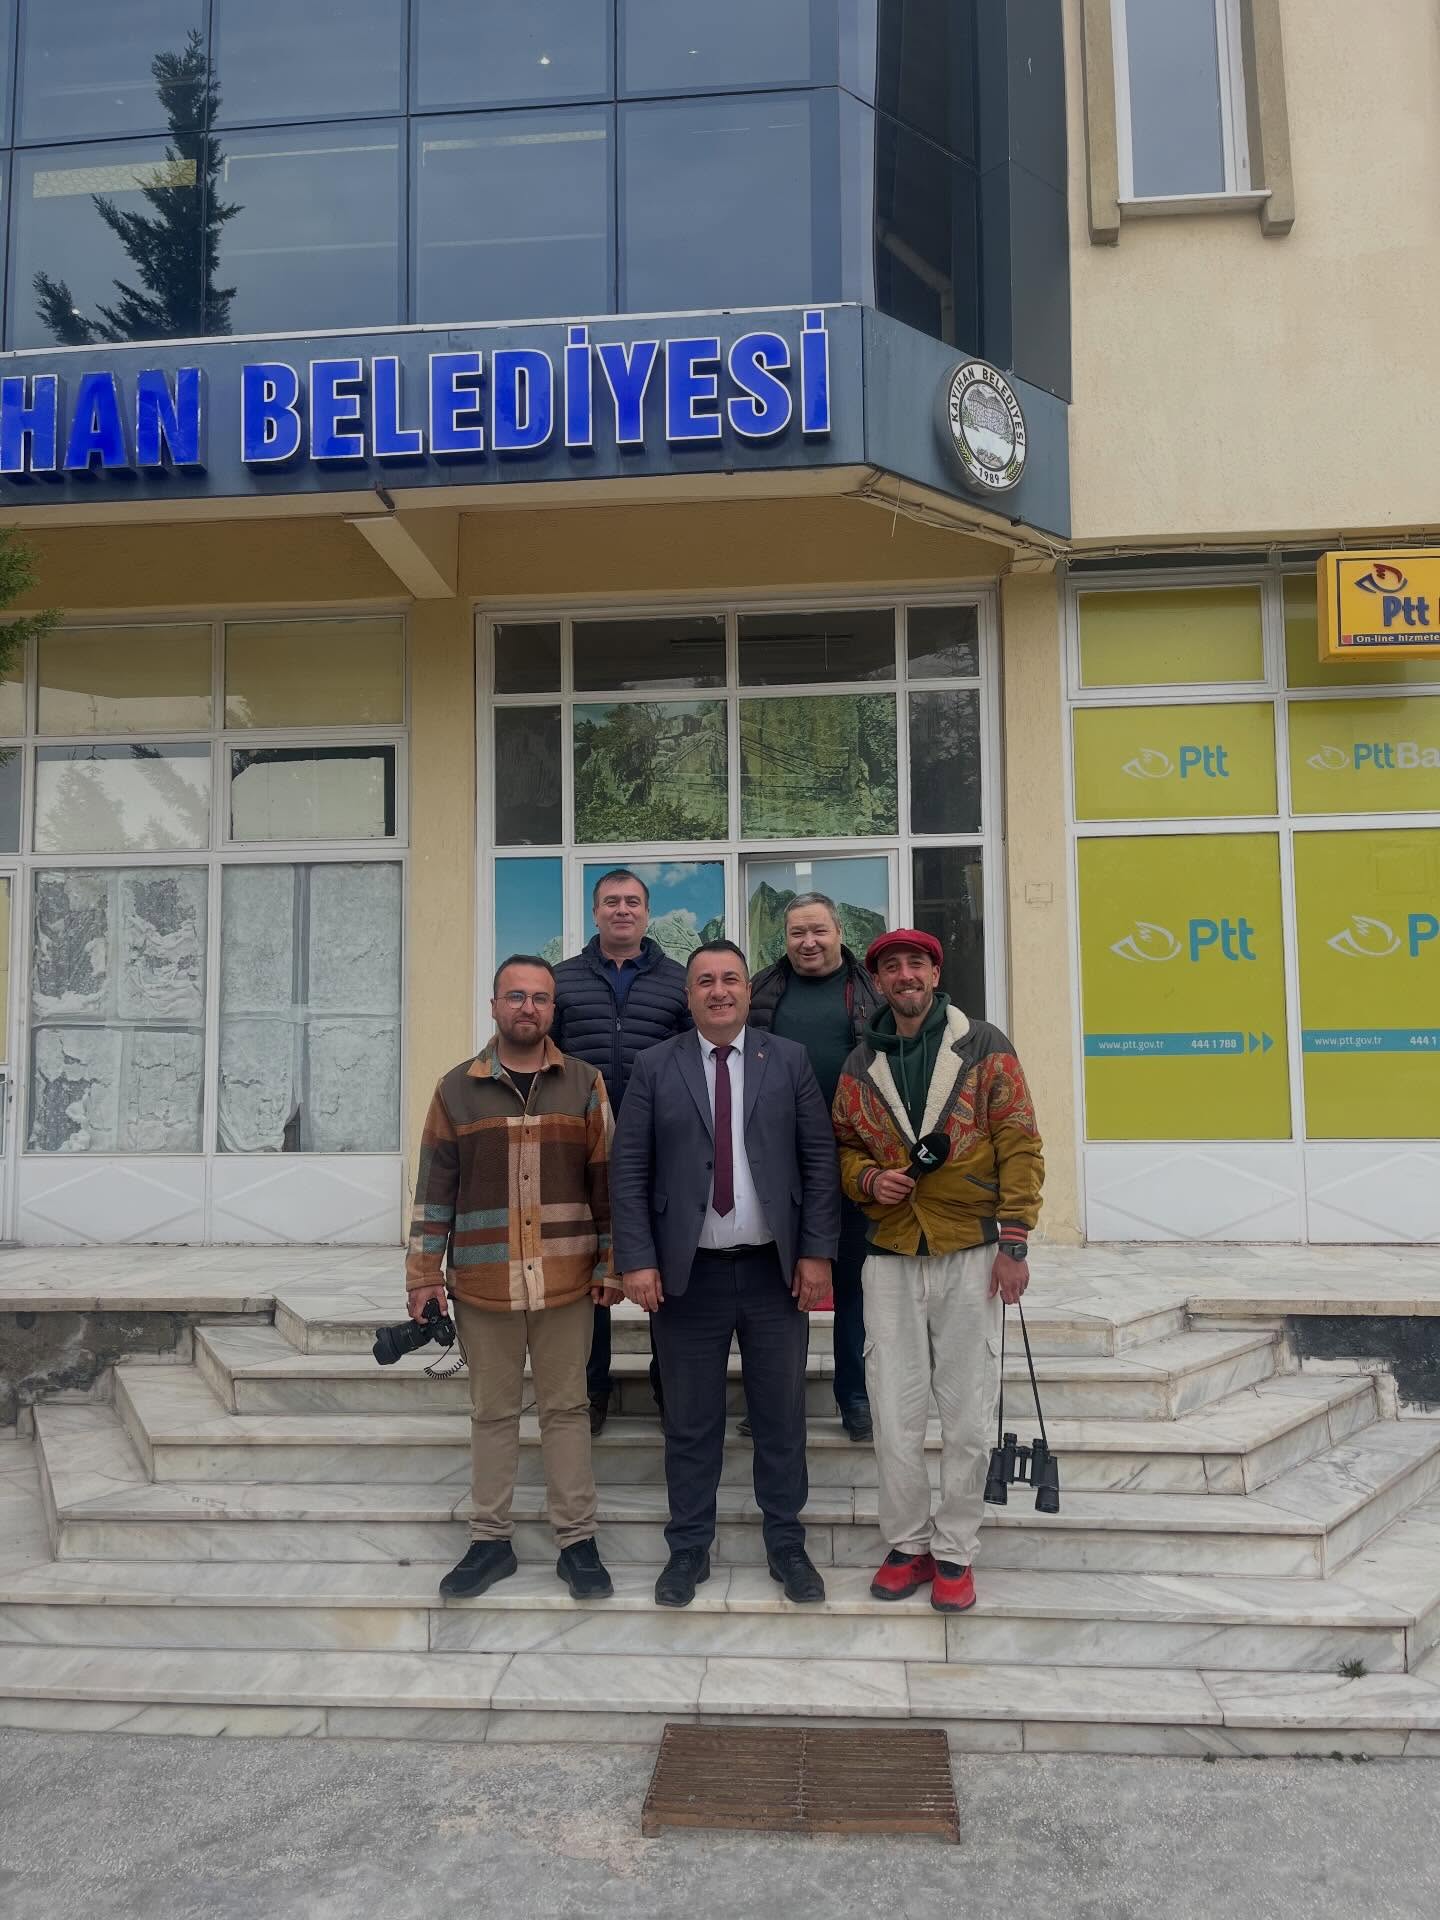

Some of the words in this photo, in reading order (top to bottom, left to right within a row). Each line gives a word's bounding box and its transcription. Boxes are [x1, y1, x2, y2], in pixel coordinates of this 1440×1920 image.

[0, 367, 201, 473] HAN
[240, 309, 831, 463] BELEDİYESİ
[950, 367, 976, 423] KAYIHAN
[978, 467, 1001, 485] 1989
[1382, 595, 1430, 627] Ptt
[1356, 634, 1395, 643] On-line
[1179, 745, 1230, 778] Ptt
[1188, 917, 1257, 962] Ptt
[1098, 1038, 1165, 1051] www.ptt.gov.tr
[1190, 1039, 1210, 1049] 444
[1314, 1036, 1382, 1048] www.ptt.gov.tr
